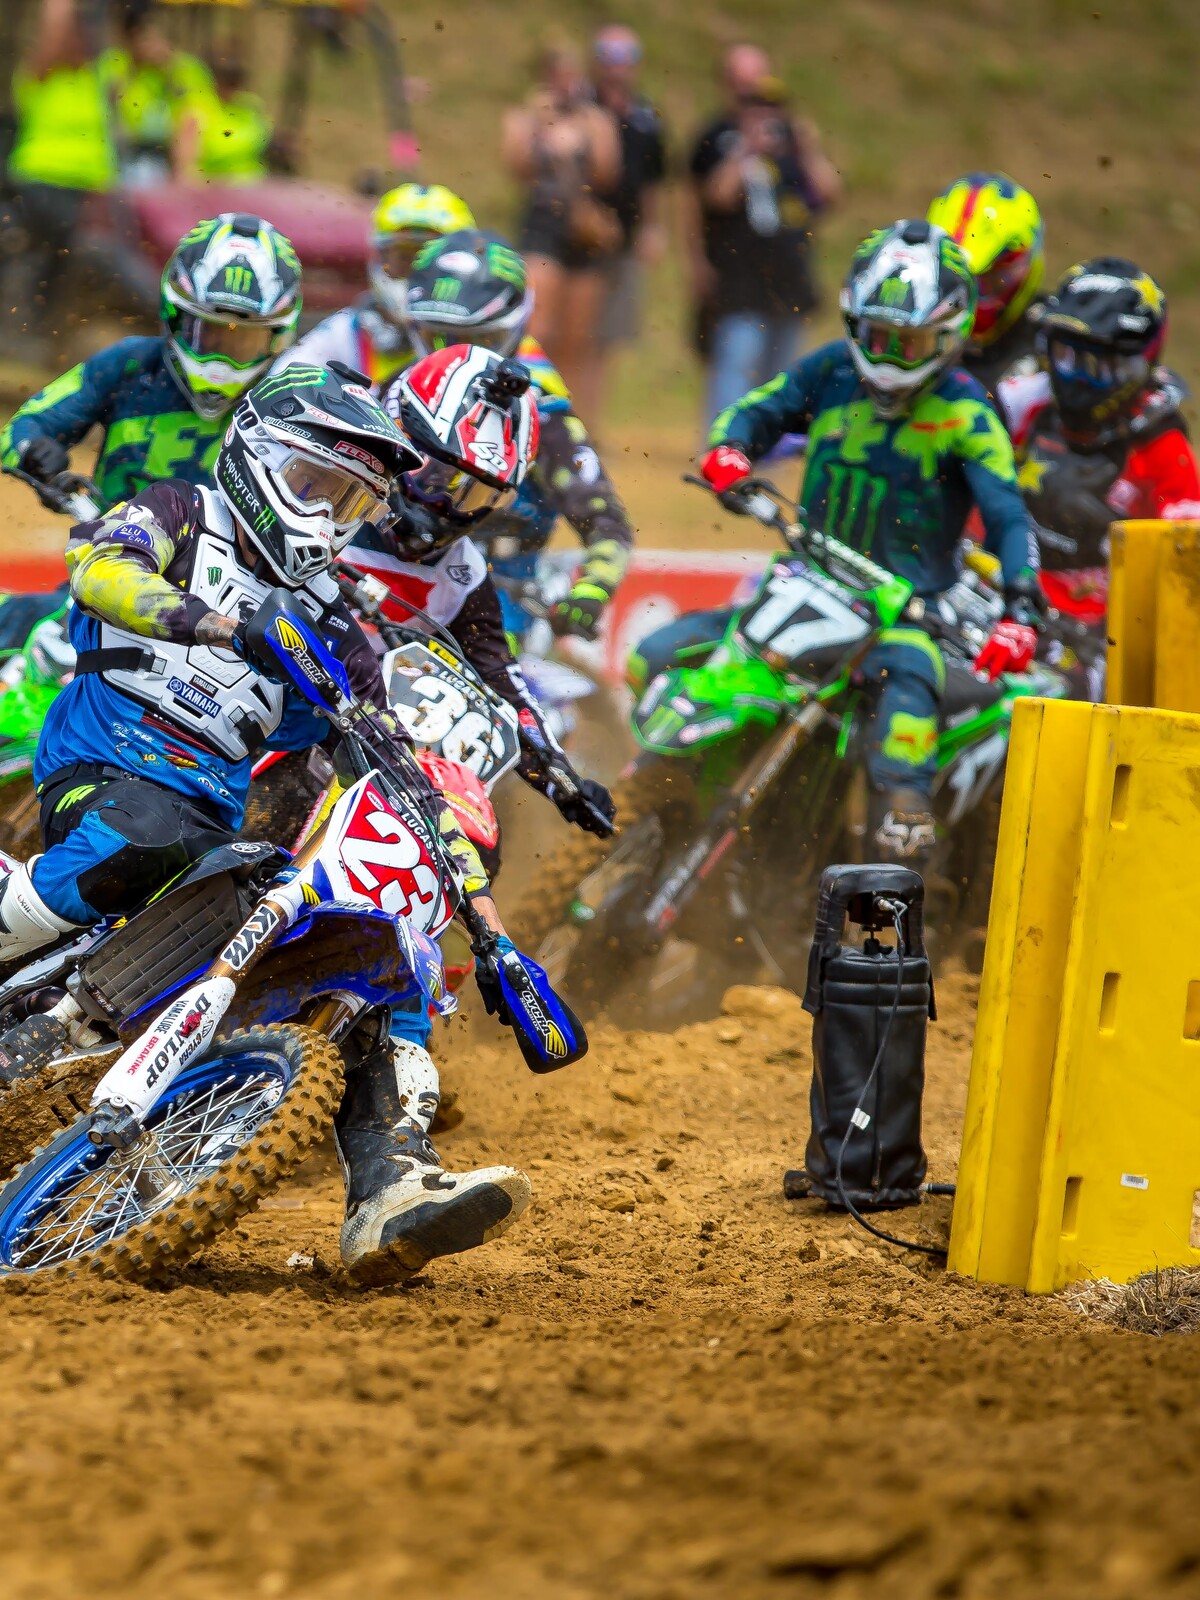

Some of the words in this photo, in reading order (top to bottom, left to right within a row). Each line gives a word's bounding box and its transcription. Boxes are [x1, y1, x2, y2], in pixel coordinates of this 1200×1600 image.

[335, 442, 376, 466] FLEX
[330, 615, 349, 628] PRO
[745, 576, 873, 661] 17
[293, 646, 326, 685] CYCRA
[181, 686, 221, 717] YAMAHA
[438, 671, 477, 701] LUCAS
[393, 675, 506, 779] 36
[400, 812, 434, 852] LUCAS
[522, 990, 551, 1035] CYCRA
[126, 1036, 160, 1077] BRAKING
